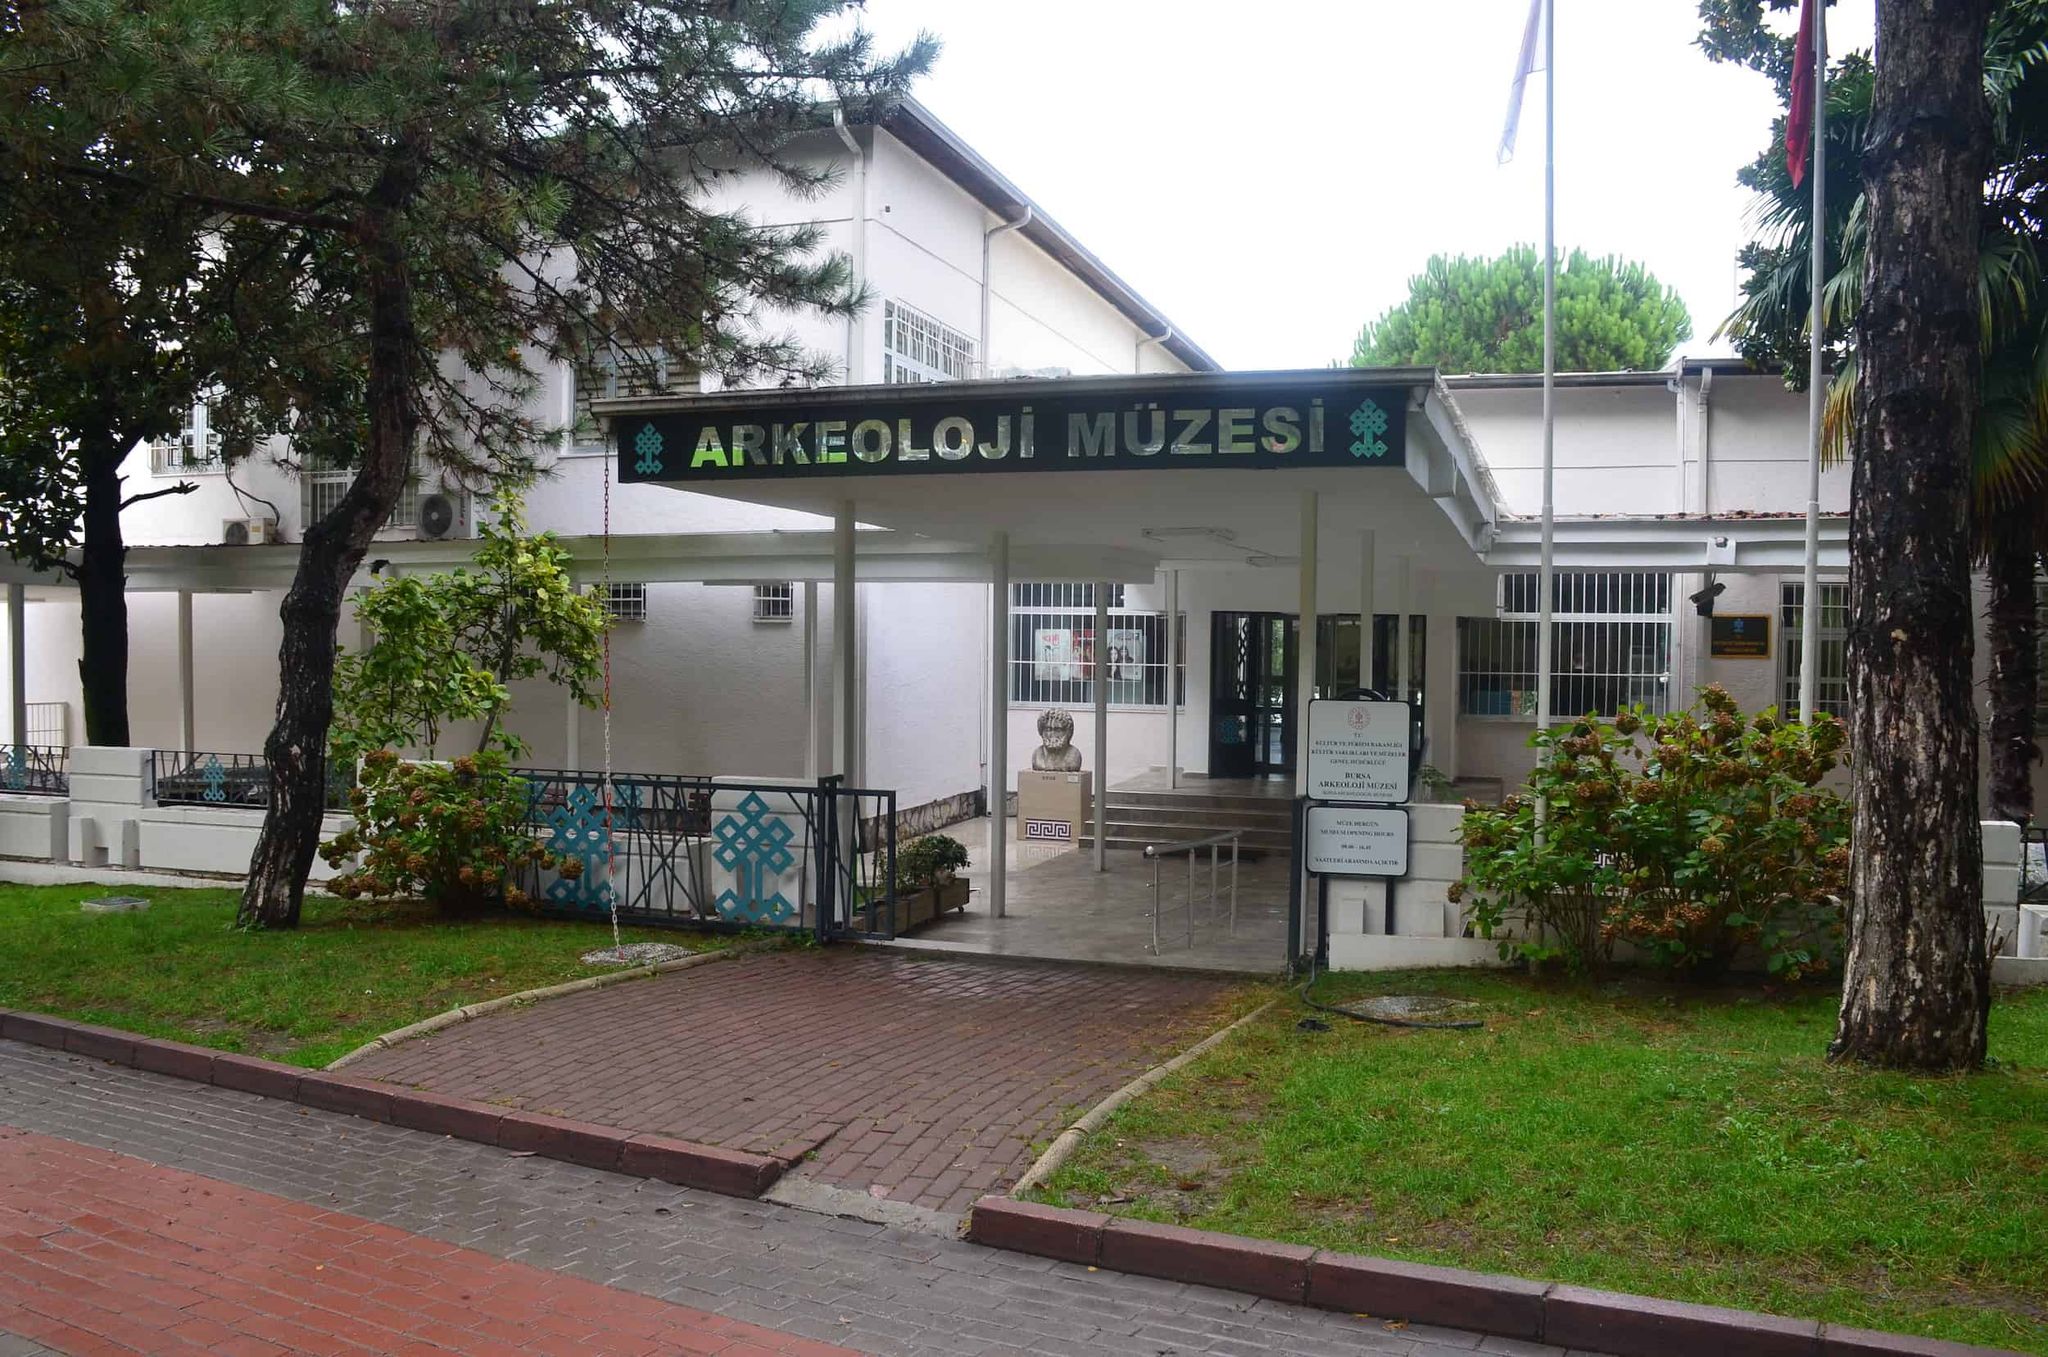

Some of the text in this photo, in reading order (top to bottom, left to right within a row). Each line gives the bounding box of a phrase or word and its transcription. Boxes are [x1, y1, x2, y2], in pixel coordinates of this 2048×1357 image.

[690, 398, 1325, 468] ARKEOLOJİ MÜZESİ
[1345, 772, 1371, 780] BURSA
